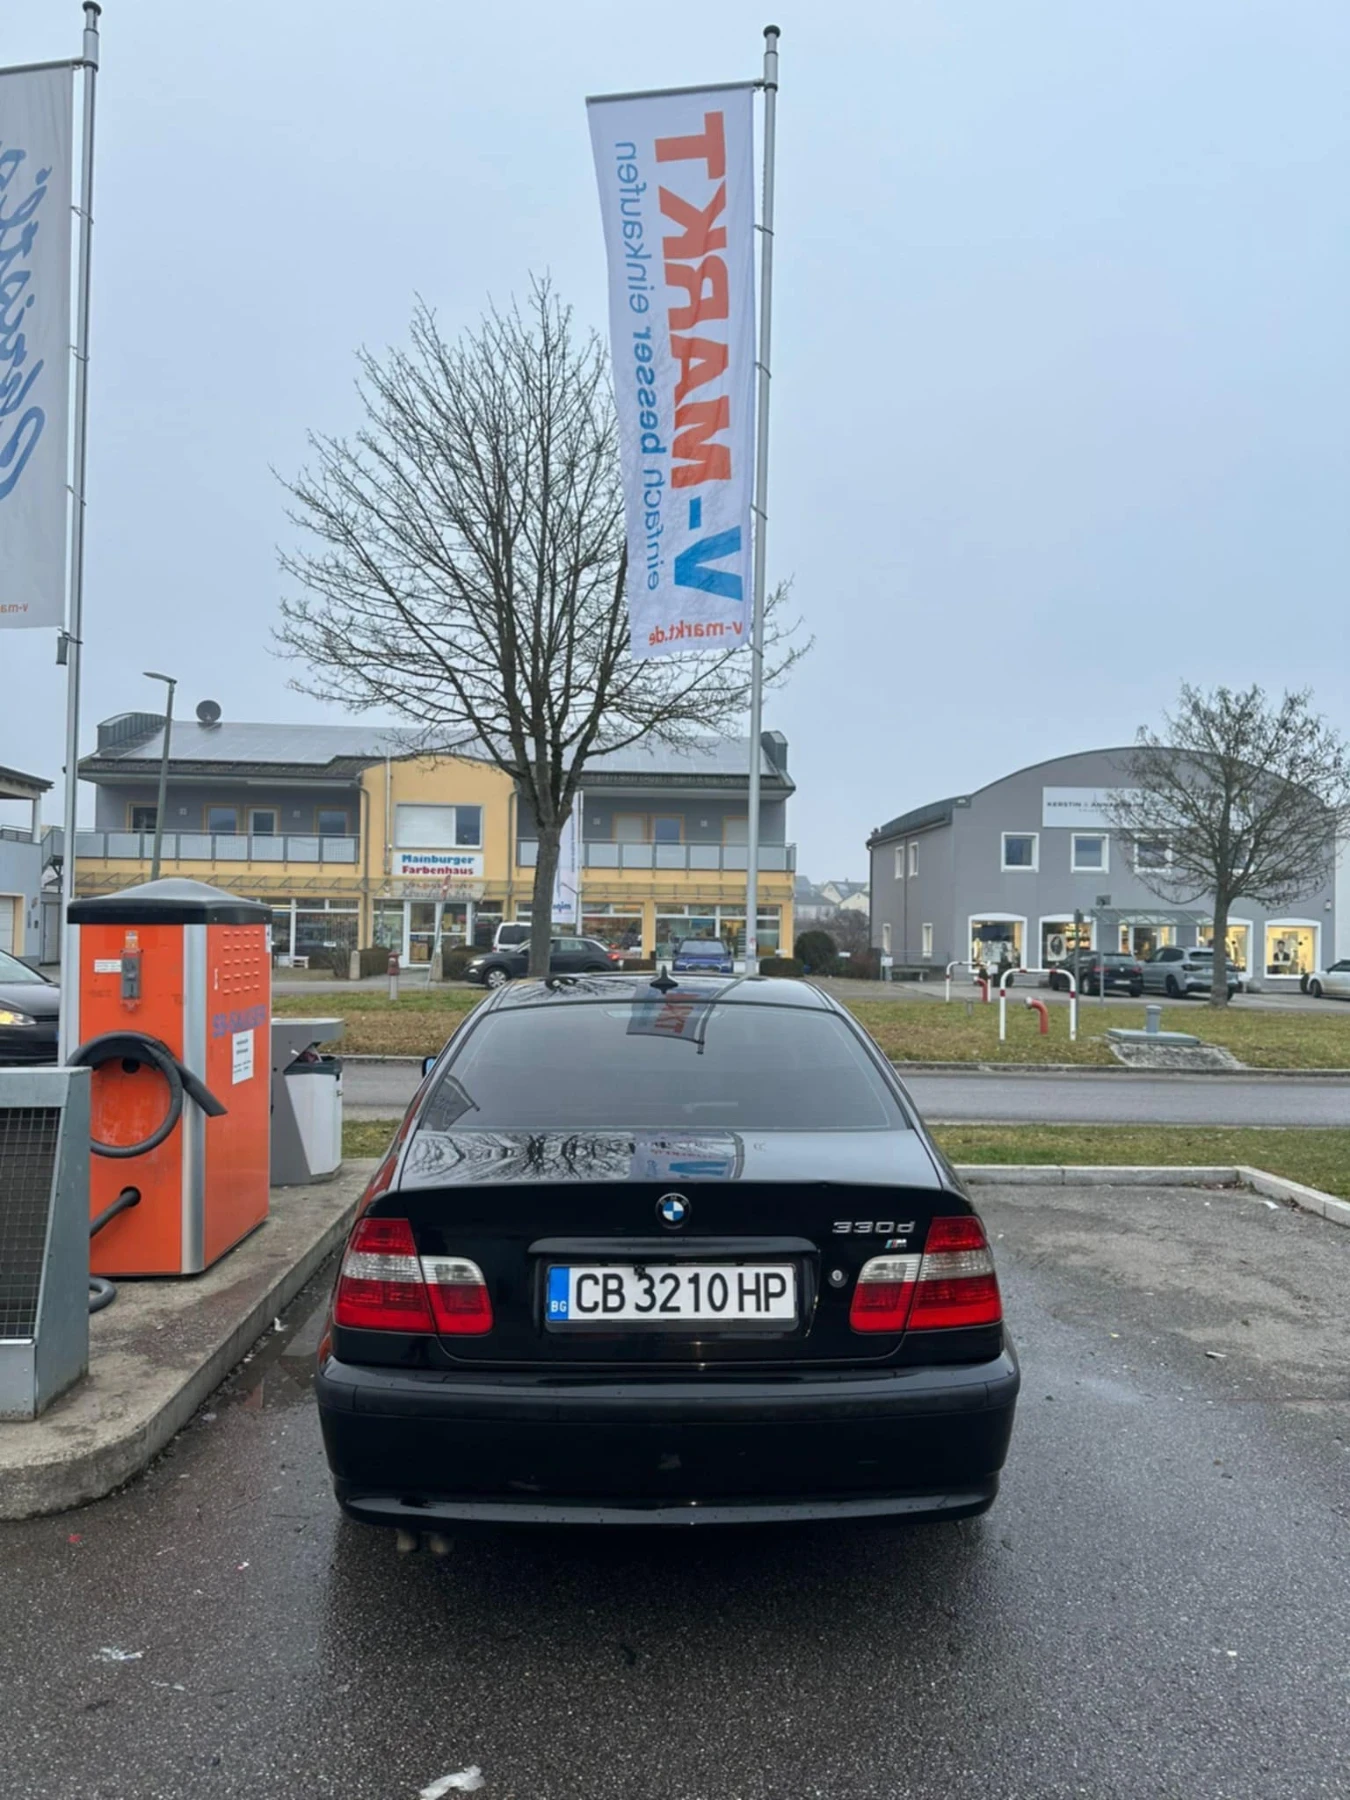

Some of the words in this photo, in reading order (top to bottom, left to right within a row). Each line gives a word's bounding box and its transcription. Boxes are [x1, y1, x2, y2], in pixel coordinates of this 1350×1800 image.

[402, 854, 475, 866] Mainburger
[402, 866, 474, 875] Farbenhaus
[832, 1221, 916, 1234] 330d
[575, 1273, 625, 1314] CB
[634, 1273, 729, 1313] 3210
[738, 1272, 787, 1313] HP
[551, 1302, 567, 1313] BG
